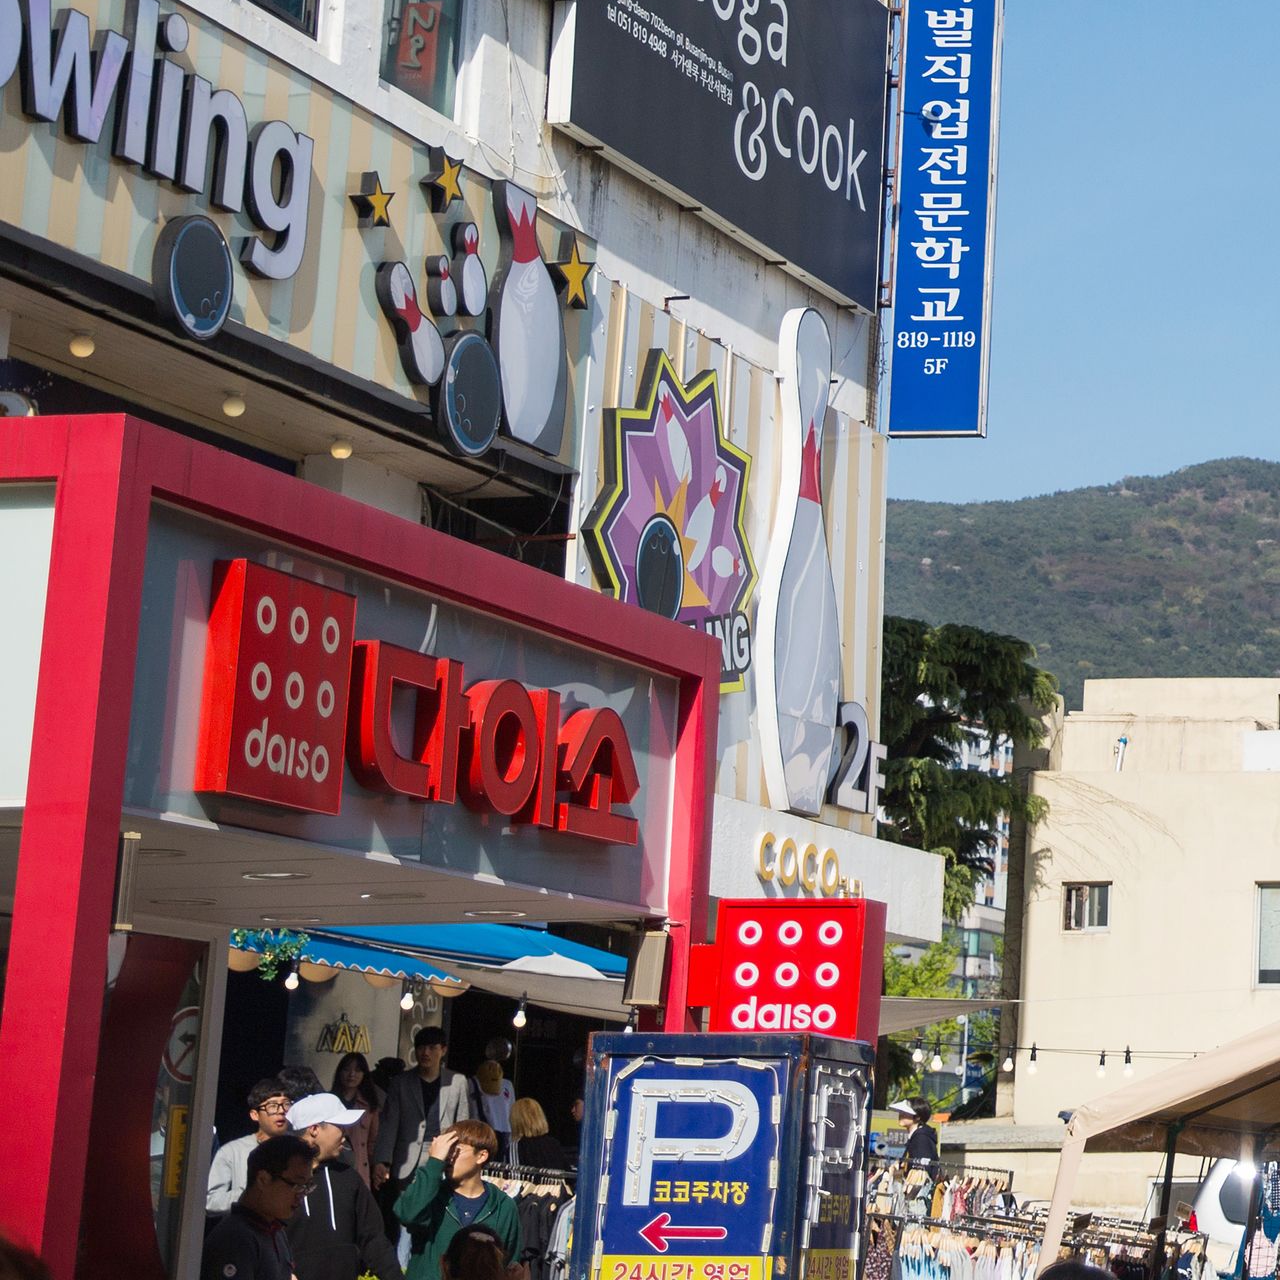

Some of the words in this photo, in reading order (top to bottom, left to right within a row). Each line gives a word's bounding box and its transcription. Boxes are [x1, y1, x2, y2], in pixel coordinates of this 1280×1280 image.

[607, 4, 616, 23] tel
[617, 11, 631, 33] 051
[632, 21, 648, 44] 819
[648, 33, 667, 58] 4948
[671, 49, 700, 82] 서가앤쿡
[700, 69, 733, 106] 부산서면점
[897, 331, 976, 349] 819-1119
[923, 358, 948, 375] 5F
[244, 717, 330, 783] daiso
[348, 638, 642, 846] 다이소
[830, 702, 887, 814] 2F
[755, 831, 839, 897] COCO
[732, 997, 836, 1029] daiso
[622, 1079, 760, 1207] P
[653, 1180, 750, 1206] 코코주차장
